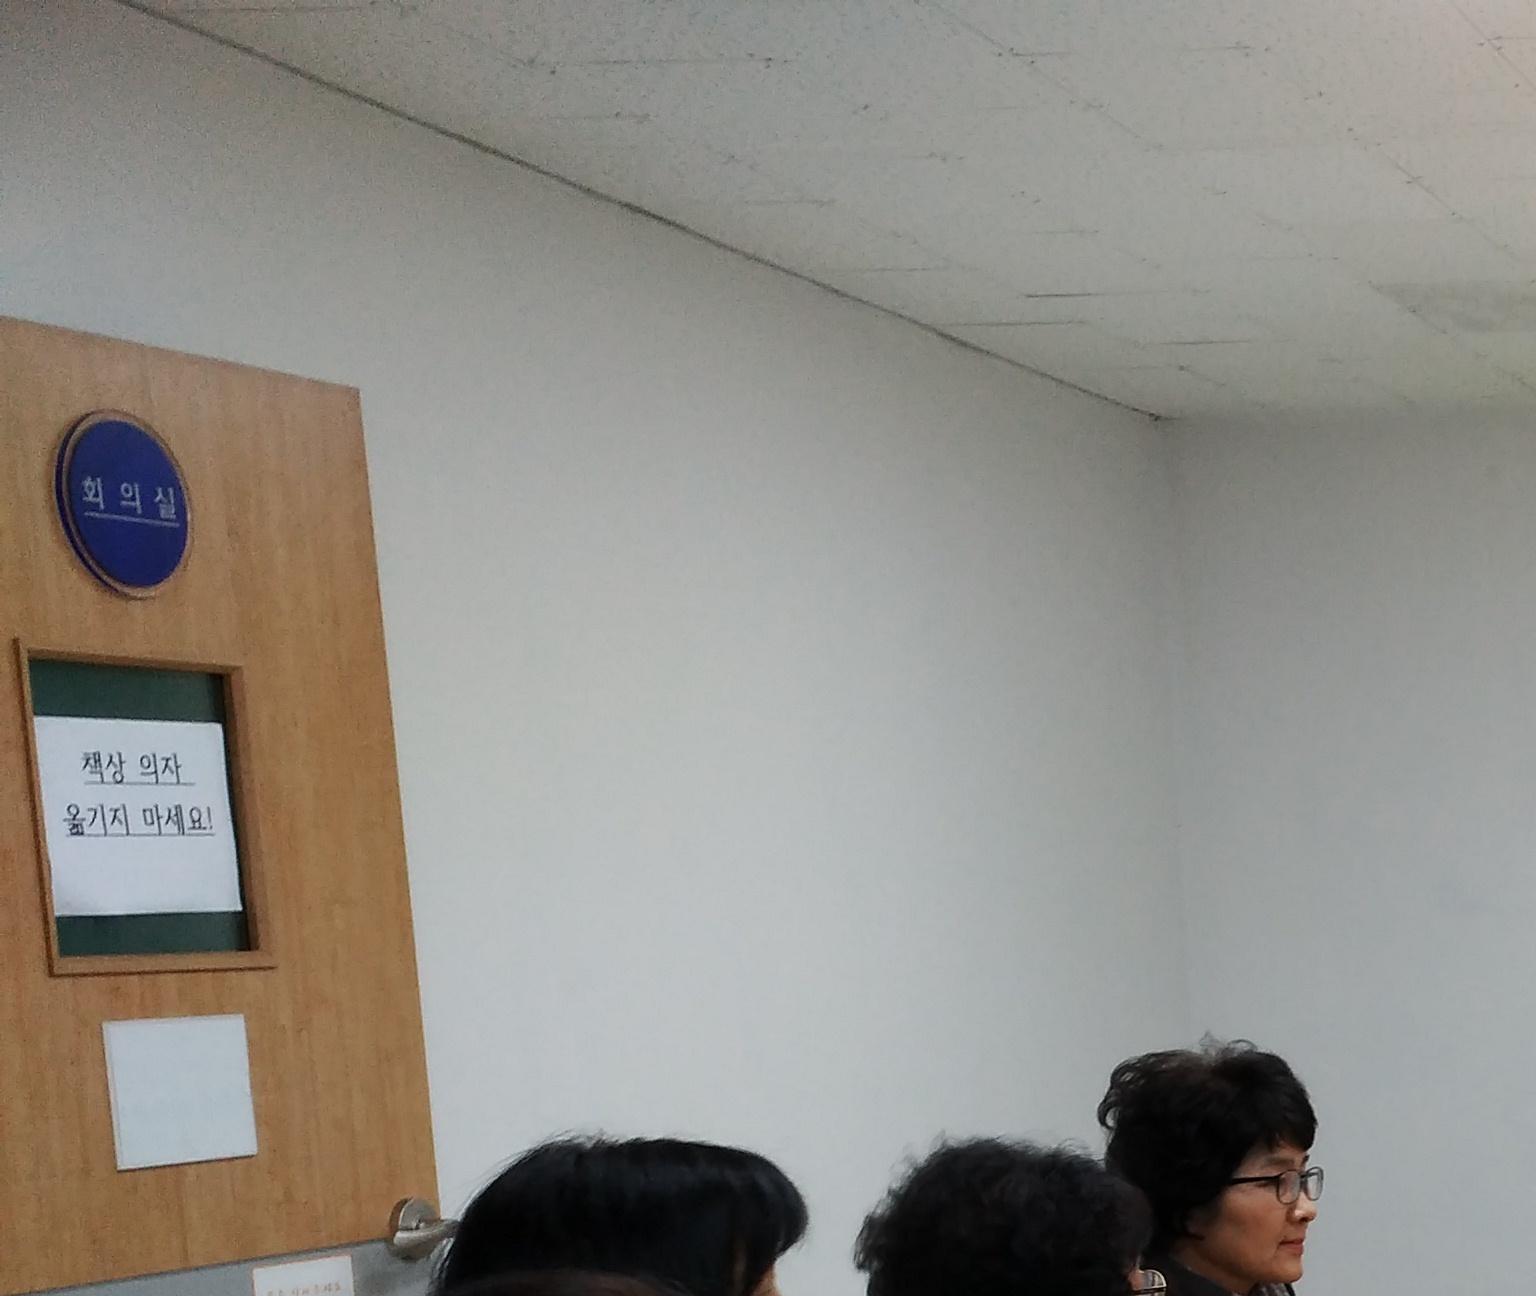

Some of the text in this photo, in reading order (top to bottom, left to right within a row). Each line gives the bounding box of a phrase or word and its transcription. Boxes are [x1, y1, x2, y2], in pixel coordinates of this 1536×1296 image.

[81, 475, 177, 519] 회의실
[81, 750, 183, 785] 책상 의자
[63, 803, 214, 836] 옮기지 마세요!
